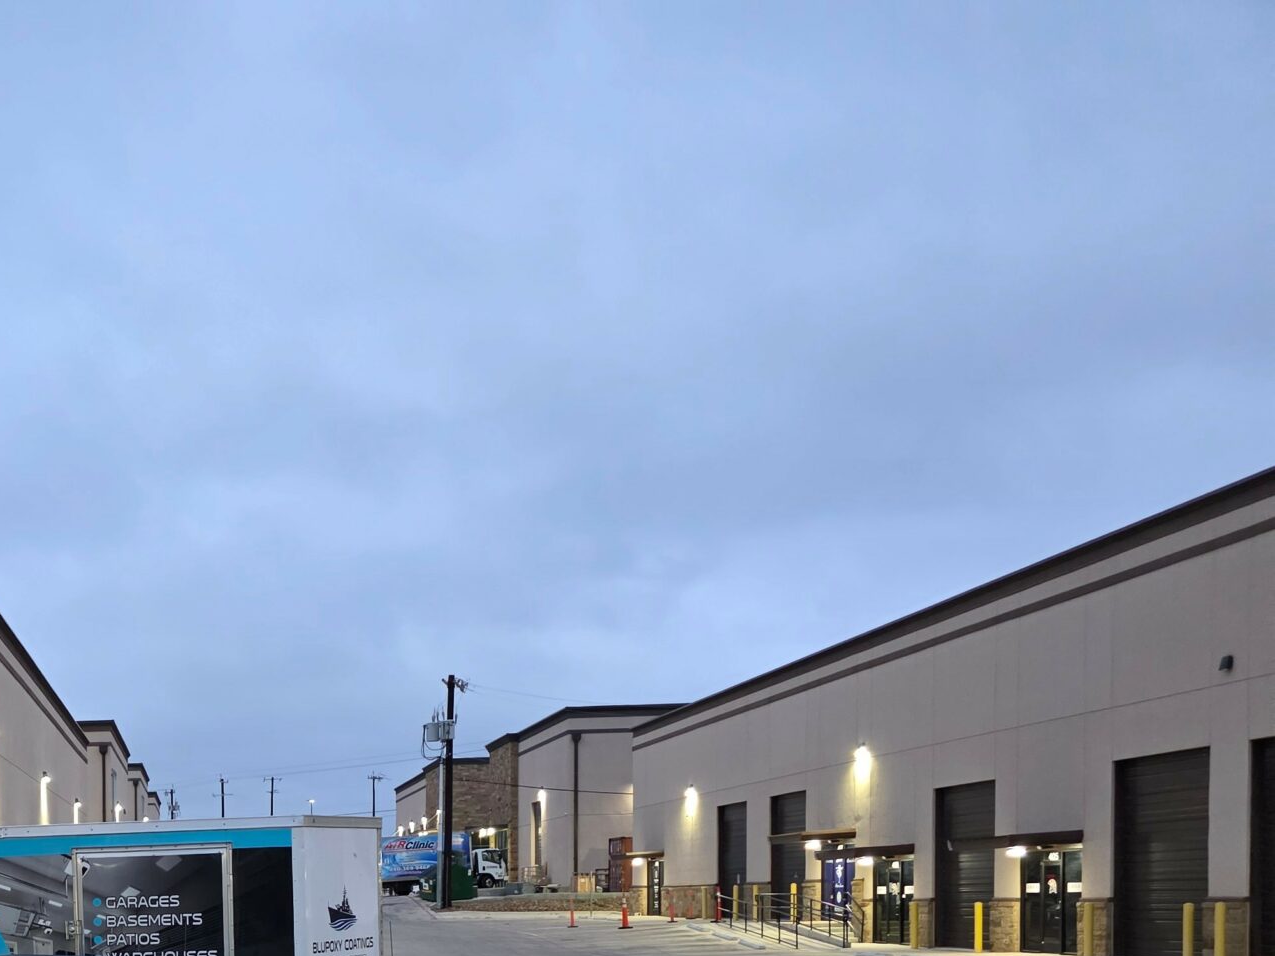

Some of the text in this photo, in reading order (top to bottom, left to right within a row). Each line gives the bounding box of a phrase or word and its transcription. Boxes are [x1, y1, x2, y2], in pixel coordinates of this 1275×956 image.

[105, 895, 180, 909] GARAGES
[106, 912, 203, 928] BASEMENTS
[106, 932, 161, 946] PATIOS
[312, 936, 374, 954] BLUPOXY COATINGS
